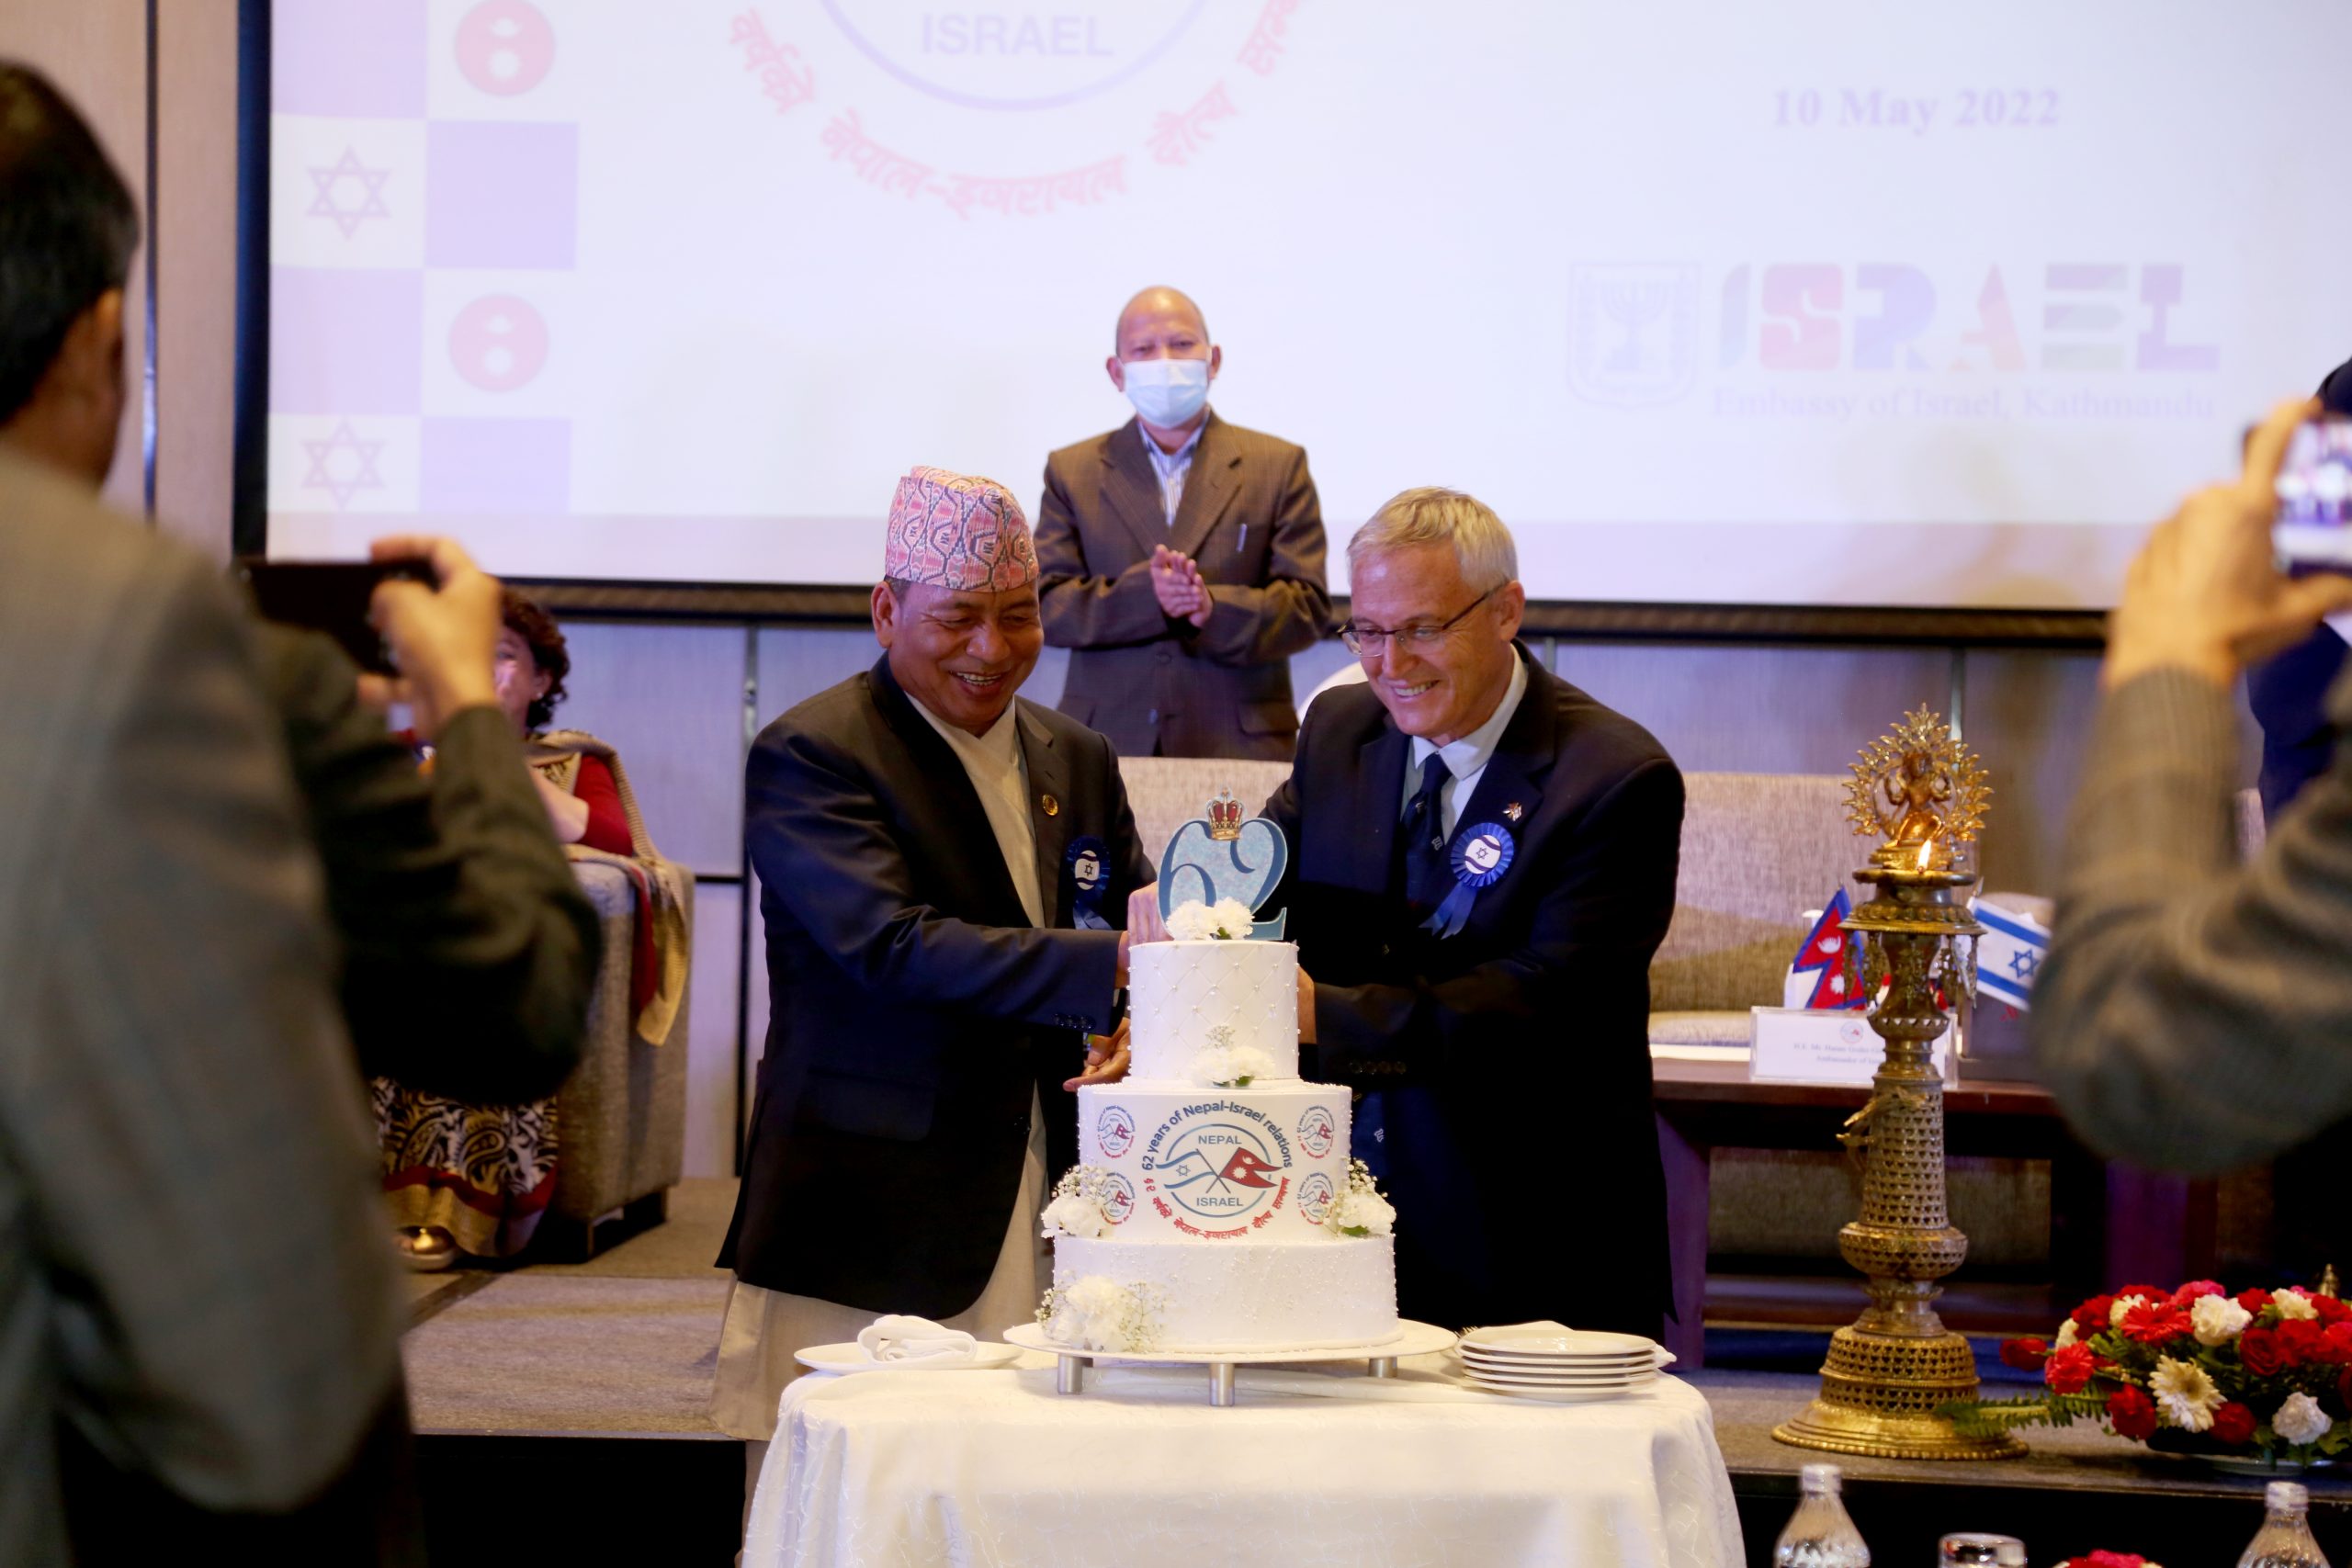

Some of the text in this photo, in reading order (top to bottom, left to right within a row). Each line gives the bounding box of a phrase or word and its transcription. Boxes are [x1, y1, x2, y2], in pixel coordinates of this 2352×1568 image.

[920, 12, 1115, 57] ISRAEL
[1772, 87, 2062, 137] 10 May 2022
[1717, 262, 2222, 372] ISRAEL
[1710, 387, 2215, 422] Embassy of Israel, Kathmandu
[1158, 818, 1287, 941] 62
[1170, 1111, 1183, 1125] of
[1182, 1100, 1267, 1123] Nepal-Israel
[1148, 1124, 1170, 1153] years
[1198, 1135, 1242, 1145] NEPAL
[1262, 1120, 1294, 1168] relations
[1142, 1156, 1155, 1170] 62
[1196, 1197, 1244, 1207] ISRAEL
